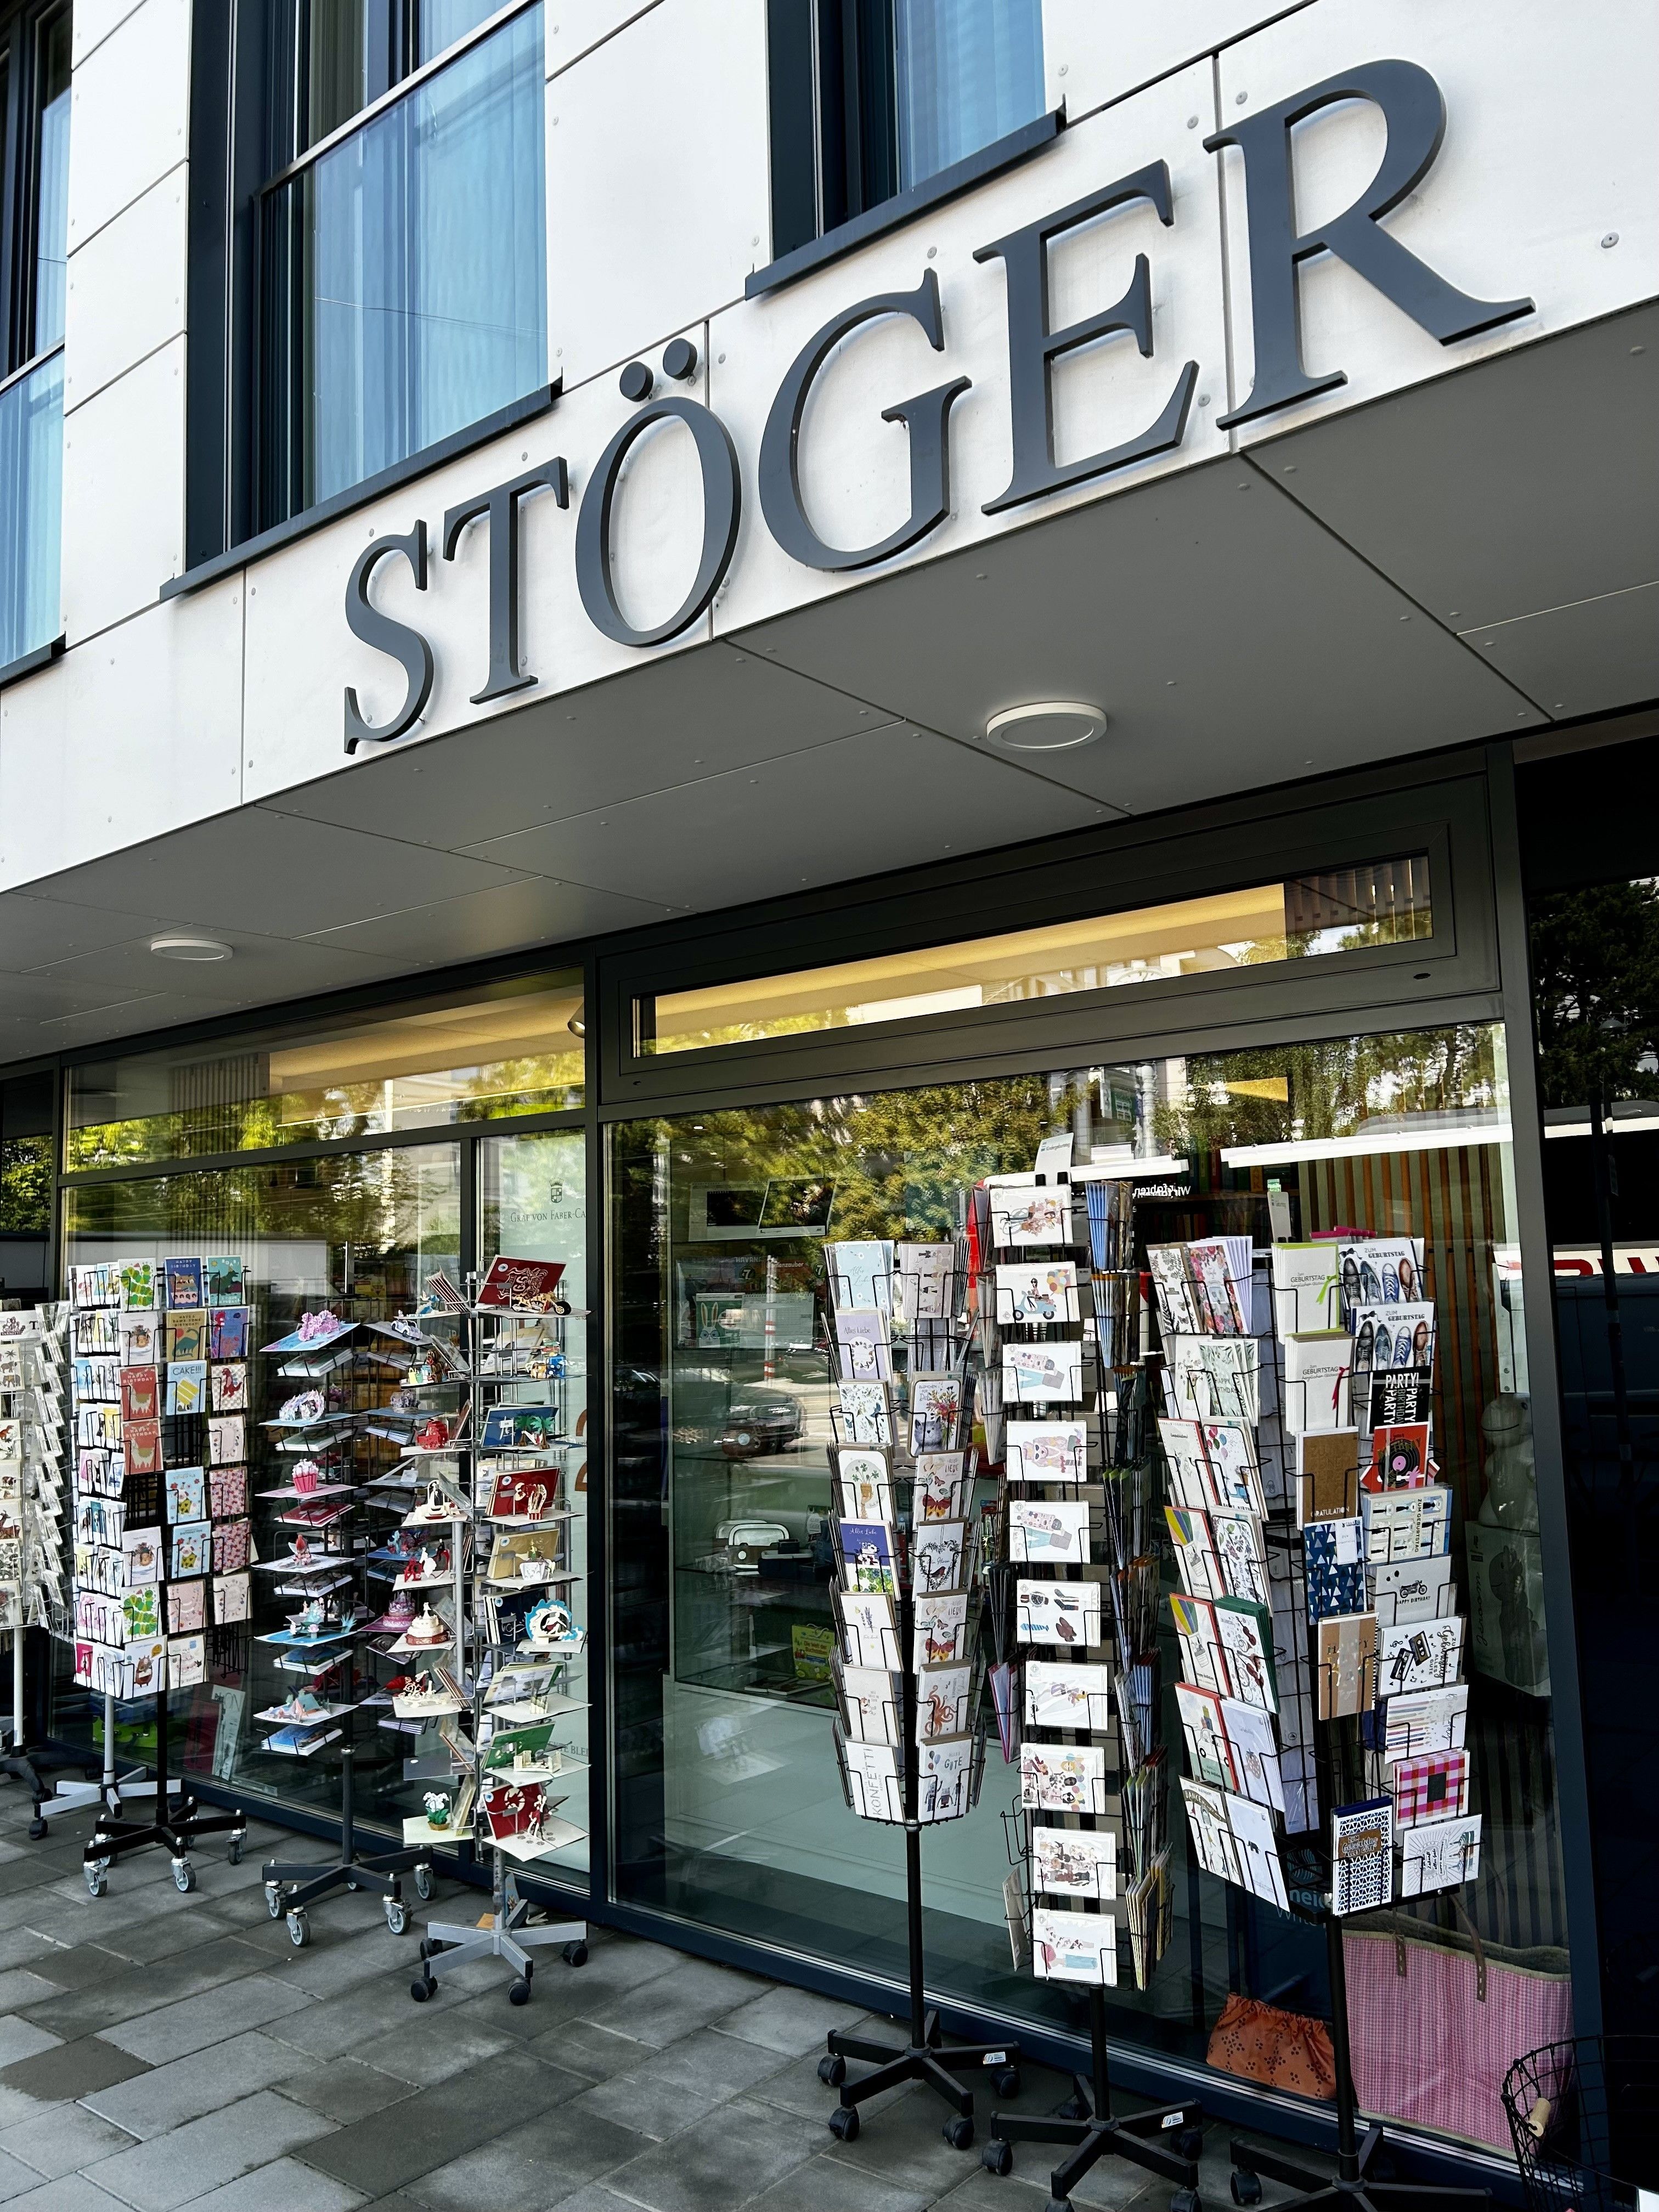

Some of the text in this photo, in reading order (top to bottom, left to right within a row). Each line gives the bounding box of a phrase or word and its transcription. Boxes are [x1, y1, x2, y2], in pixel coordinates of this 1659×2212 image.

[343, 58, 1536, 755] STÖGER
[1290, 1274, 1325, 1283] GEBURTSTAG
[844, 1326, 856, 1334] Alles
[173, 1366, 201, 1375] CAKE!!!
[1303, 1366, 1339, 1375] GEBURTSTAG
[1385, 1373, 1419, 1389] PARTY!
[1384, 1389, 1396, 1424] PARTY
[1404, 1388, 1418, 1422] PARTY
[945, 1463, 959, 1473] LIEBE
[863, 1748, 882, 1815] KONFETTI
[1185, 1791, 1202, 1803] DANCE
